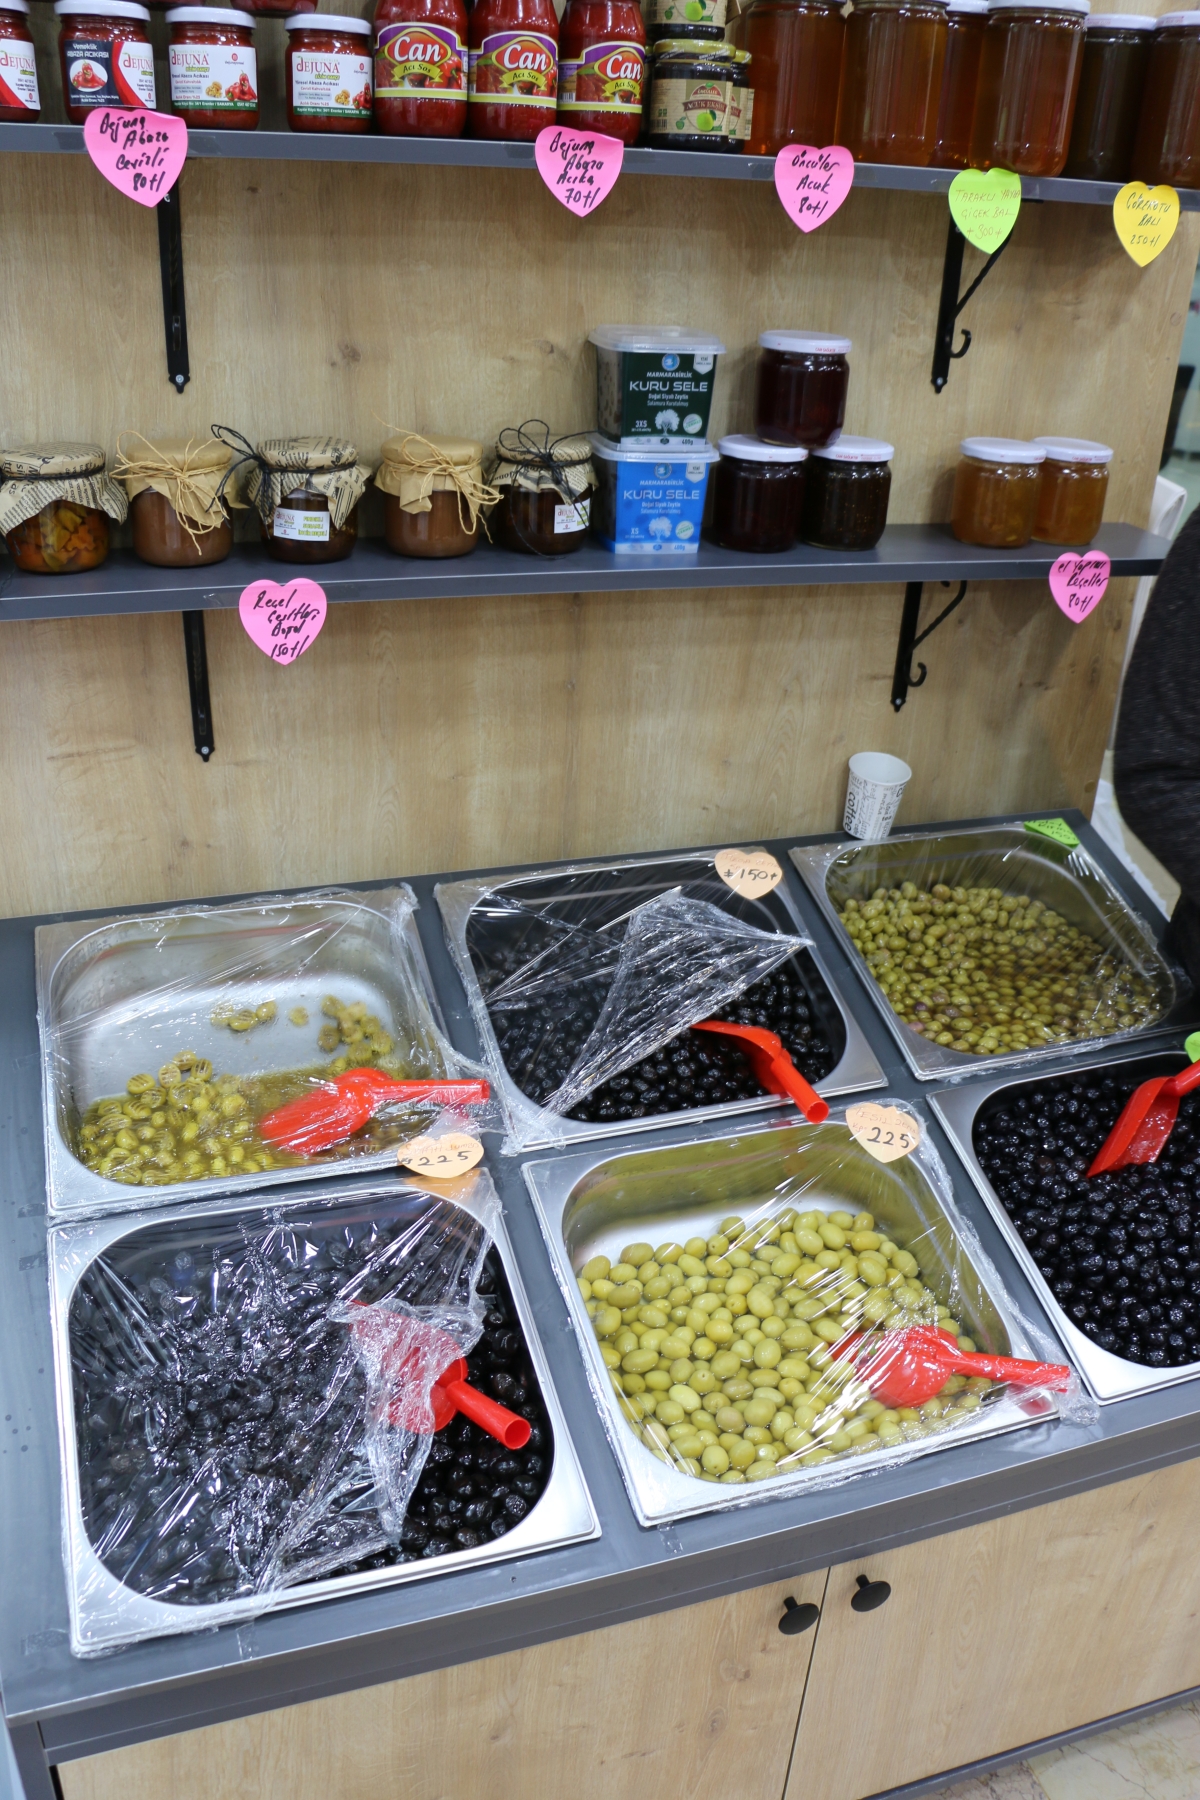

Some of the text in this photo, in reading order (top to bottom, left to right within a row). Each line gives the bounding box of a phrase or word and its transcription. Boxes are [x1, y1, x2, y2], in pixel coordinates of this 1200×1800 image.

[393, 36, 442, 63] Can
[503, 44, 547, 71] Can
[605, 55, 642, 80] Can
[630, 381, 708, 392] KURU SELE
[623, 490, 700, 500] KURU SELE
[844, 791, 856, 831] coffee
[867, 1127, 916, 1149] 225
